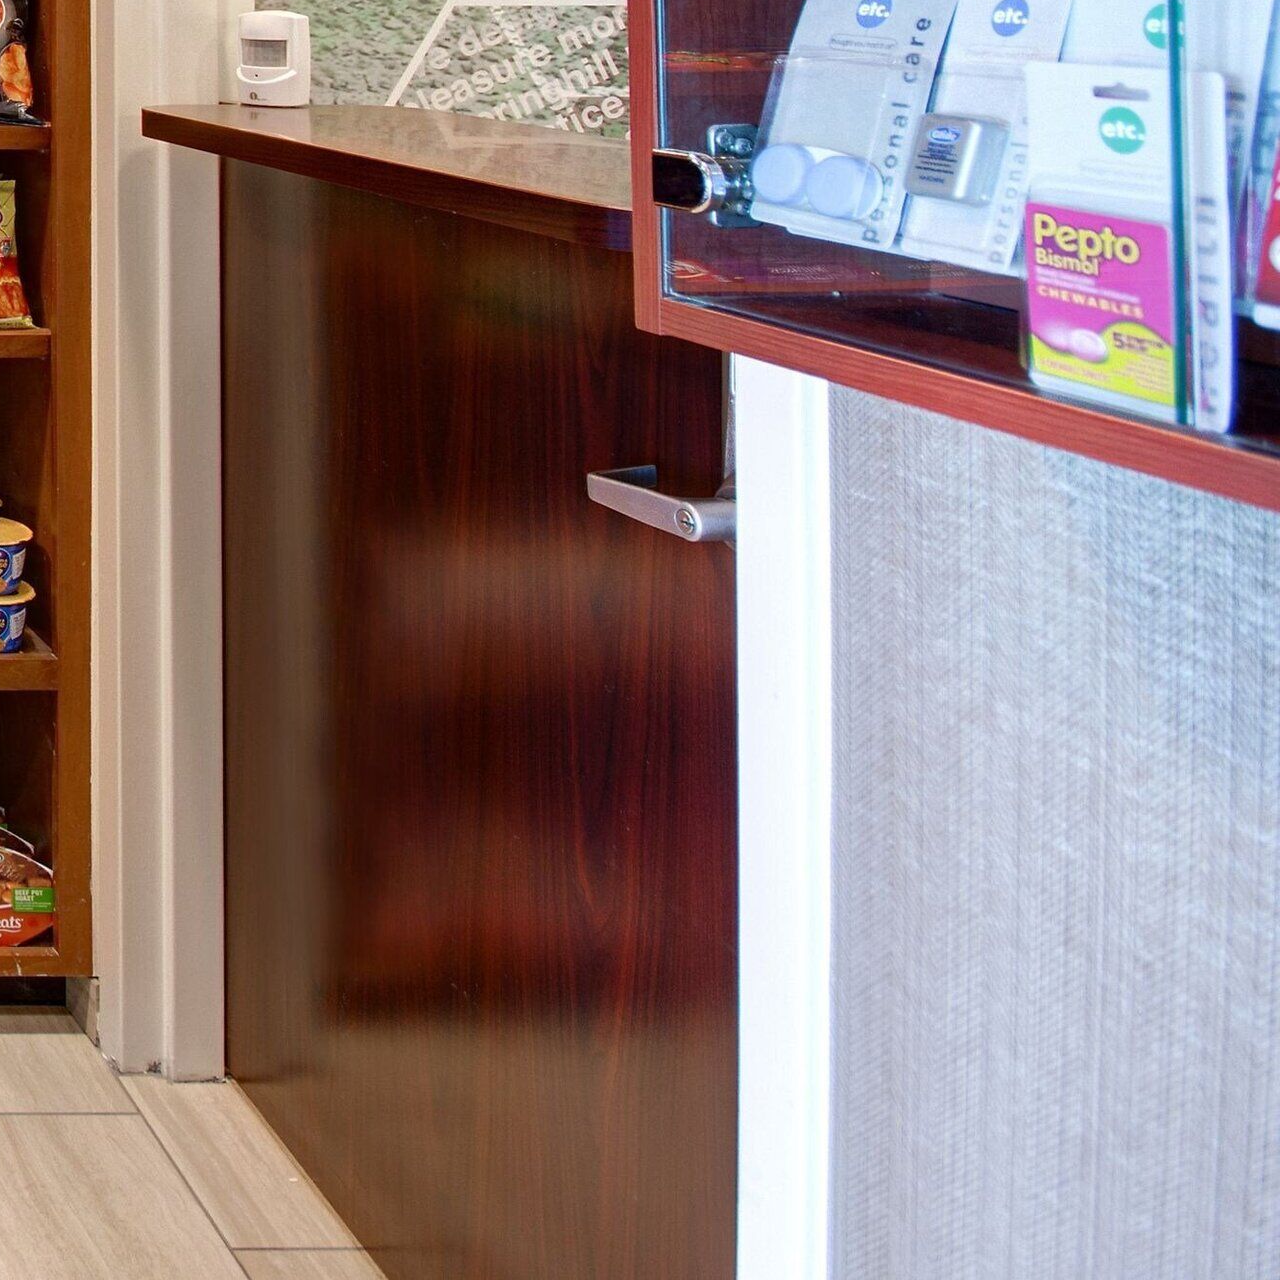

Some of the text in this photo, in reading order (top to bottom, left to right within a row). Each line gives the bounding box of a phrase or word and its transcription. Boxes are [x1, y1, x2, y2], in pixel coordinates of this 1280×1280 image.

[858, 2, 890, 18] etc.
[993, 8, 1028, 24] etc.
[903, 18, 931, 84] care
[862, 102, 910, 243] personal
[1034, 213, 1140, 264] Pepto
[1036, 248, 1099, 276] Bismol
[1037, 286, 1144, 320] CHEWABLES
